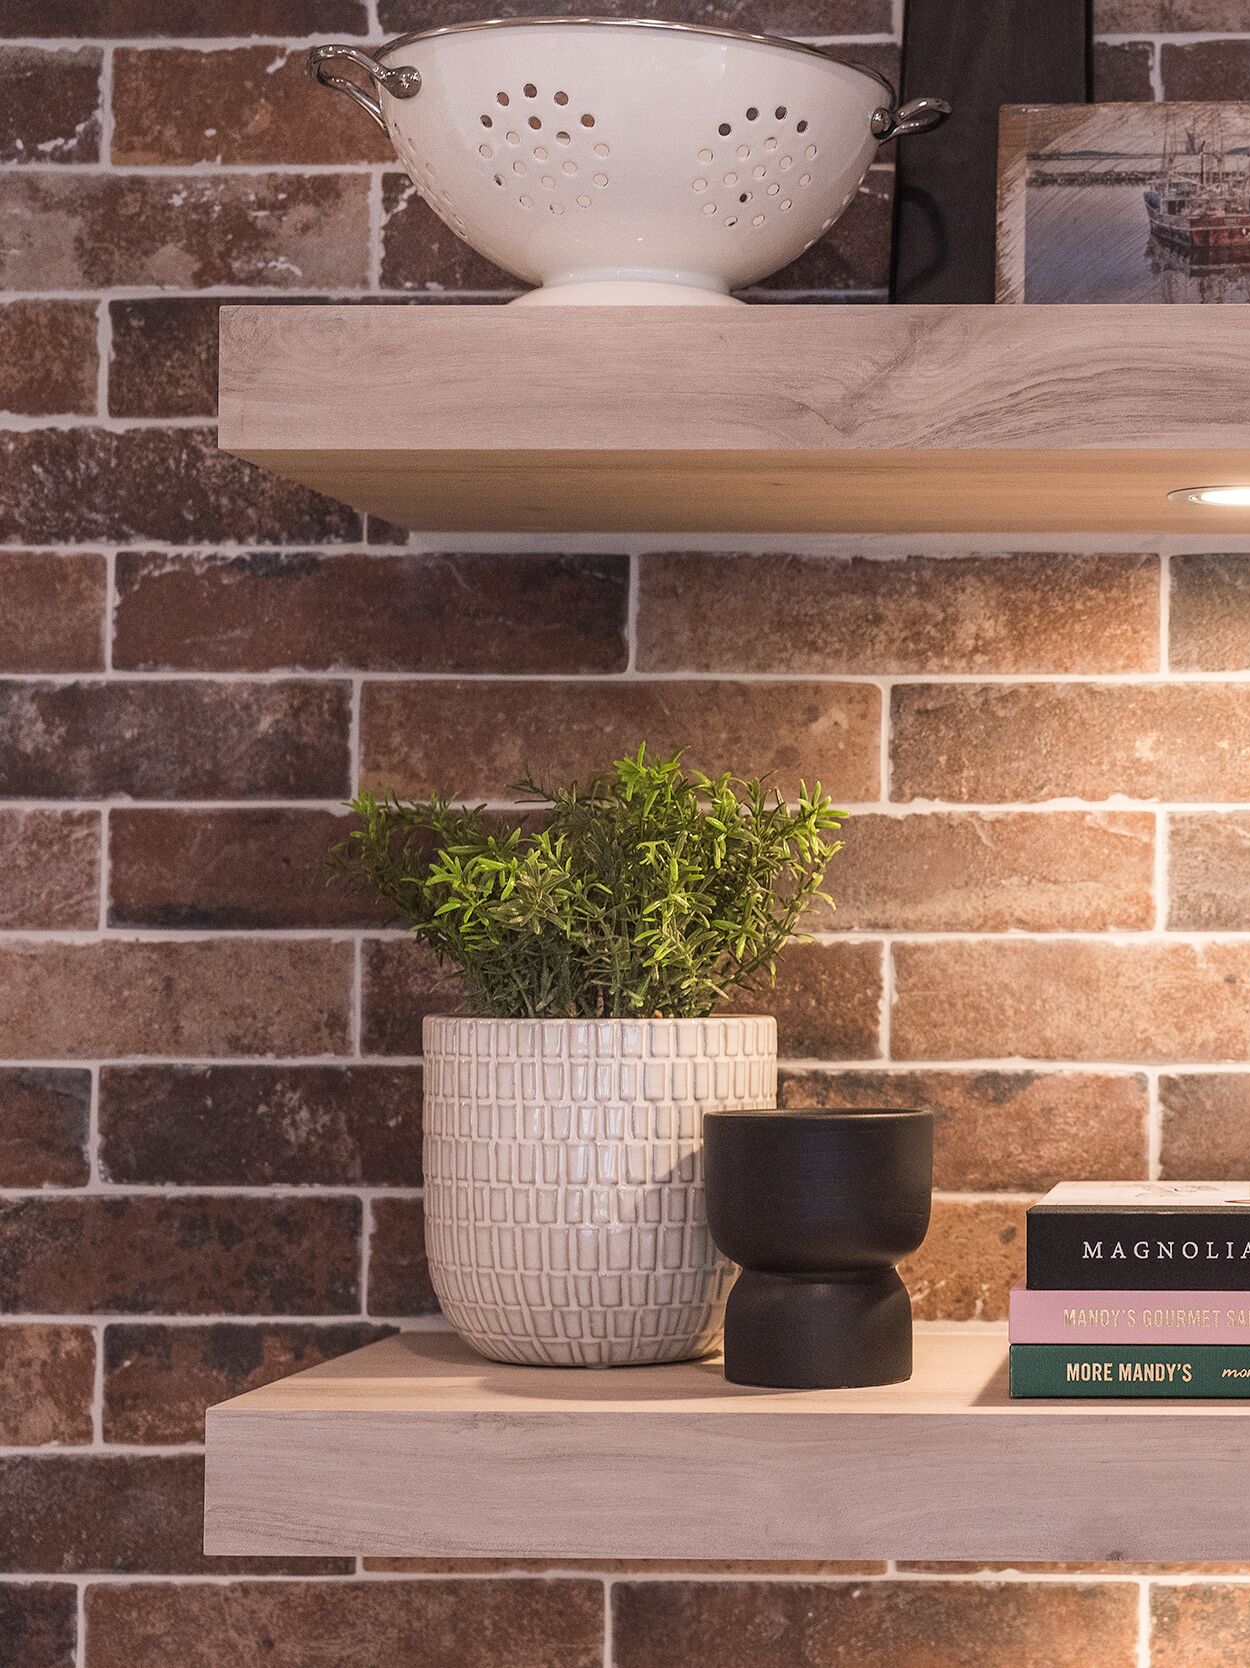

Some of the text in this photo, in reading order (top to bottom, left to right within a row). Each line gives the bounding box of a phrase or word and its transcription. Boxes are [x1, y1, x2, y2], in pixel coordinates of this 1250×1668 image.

[1063, 1308, 1137, 1327] MANDY'S
[1142, 1309, 1221, 1328] GOURMET
[1066, 1363, 1193, 1383] MORE MANDY'S
